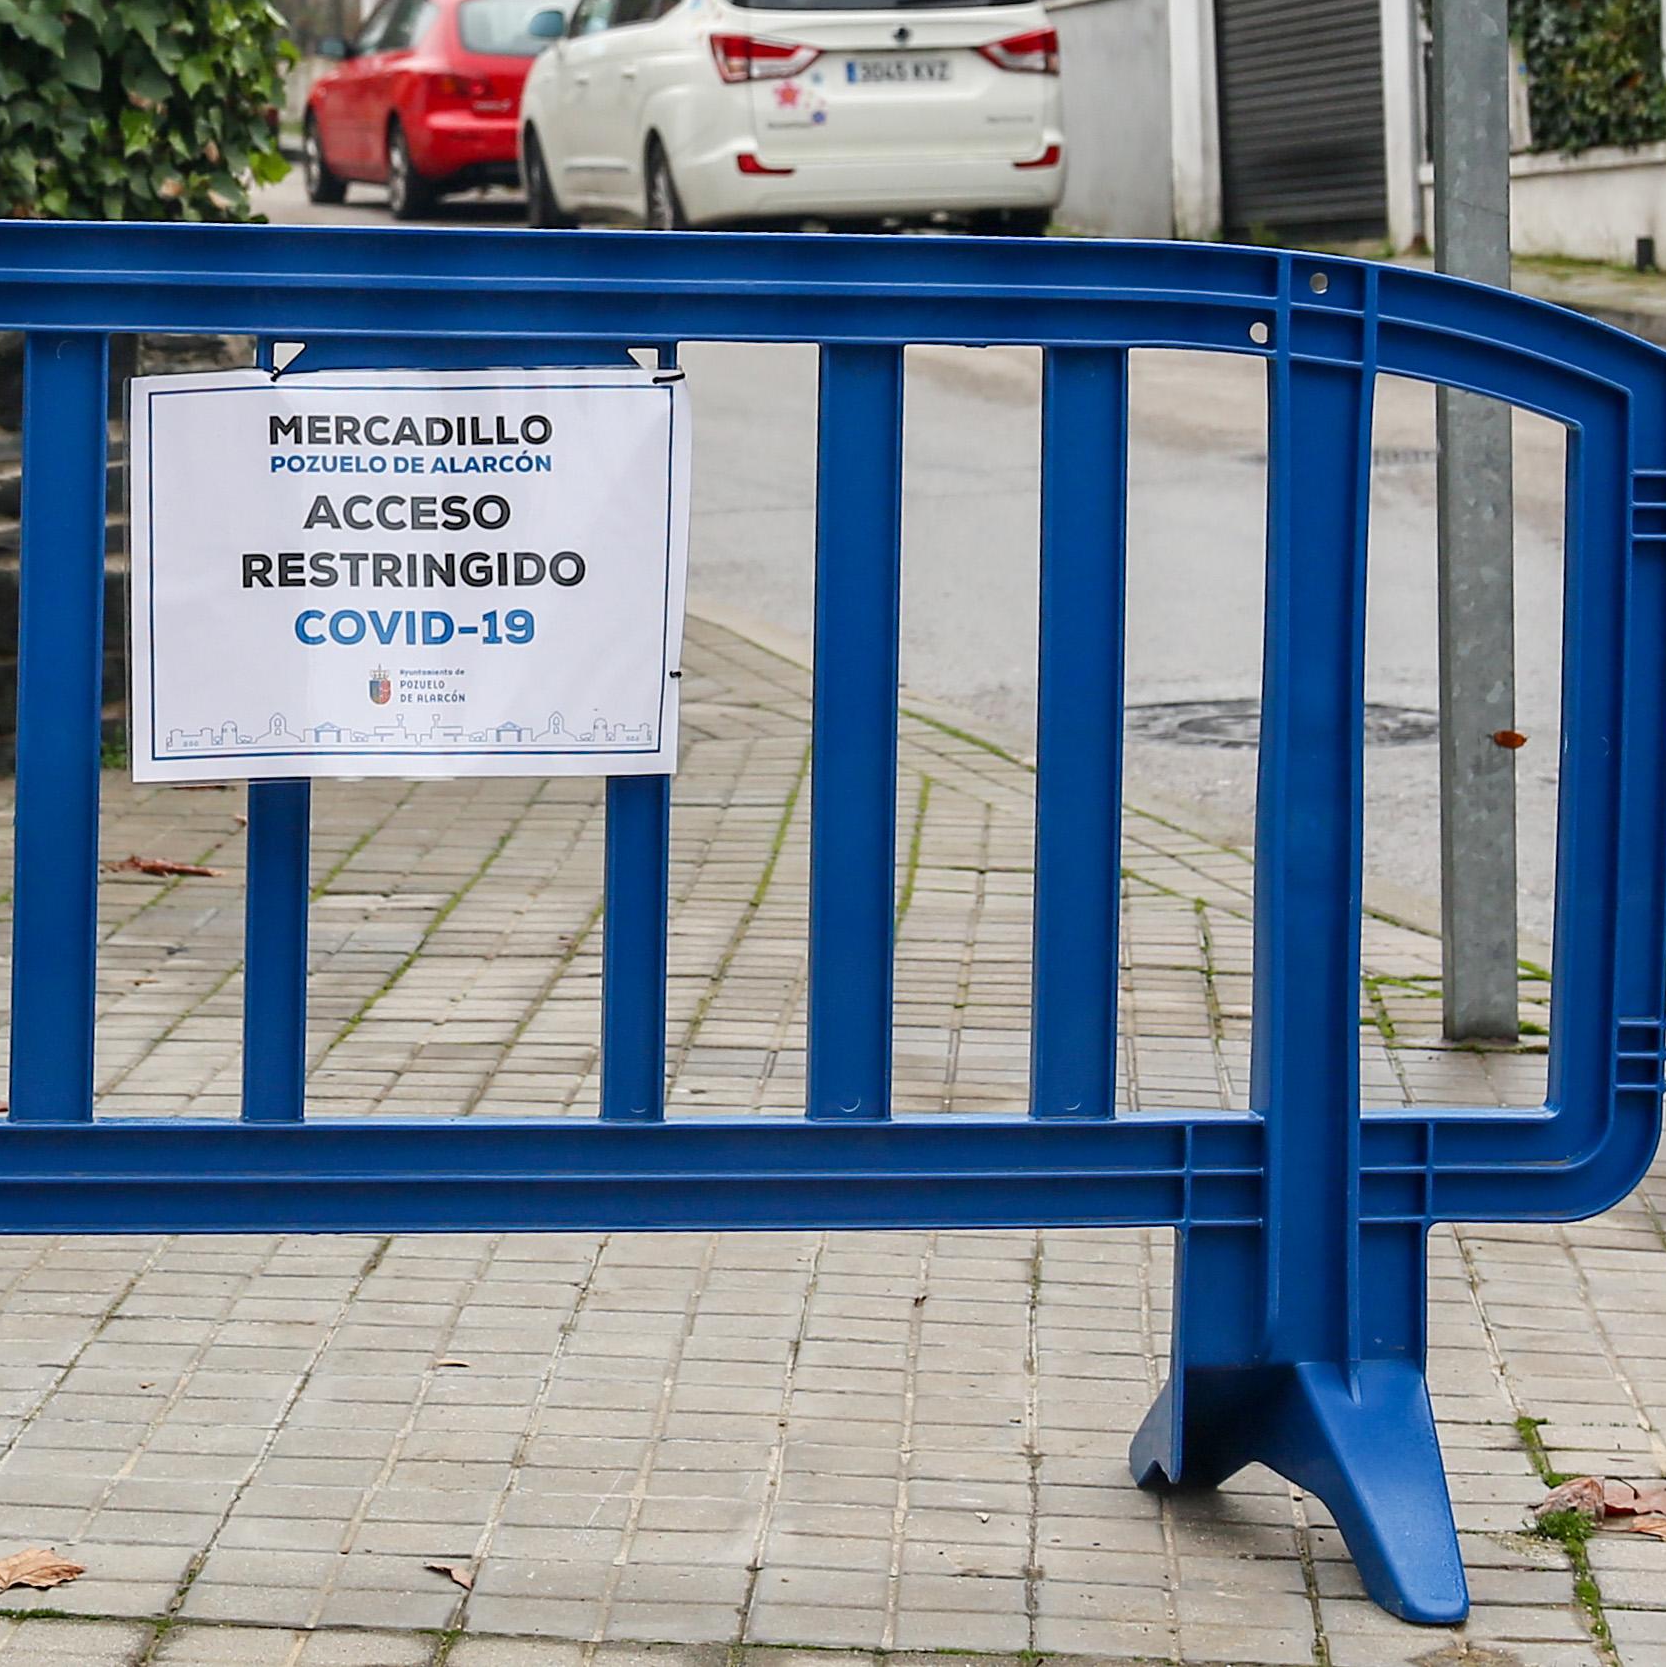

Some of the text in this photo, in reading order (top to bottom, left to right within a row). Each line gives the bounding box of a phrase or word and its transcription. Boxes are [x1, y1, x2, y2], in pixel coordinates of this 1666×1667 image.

[269, 414, 553, 446] MERCADILLO
[270, 450, 552, 474] POZUELO DE ALARCÓN
[302, 494, 511, 531] ACCESO
[241, 551, 586, 588] RESTRINGIDO
[294, 609, 536, 645] COVID-19
[400, 680, 445, 689] POZUELO
[400, 689, 466, 702] DE ALARCÓN
